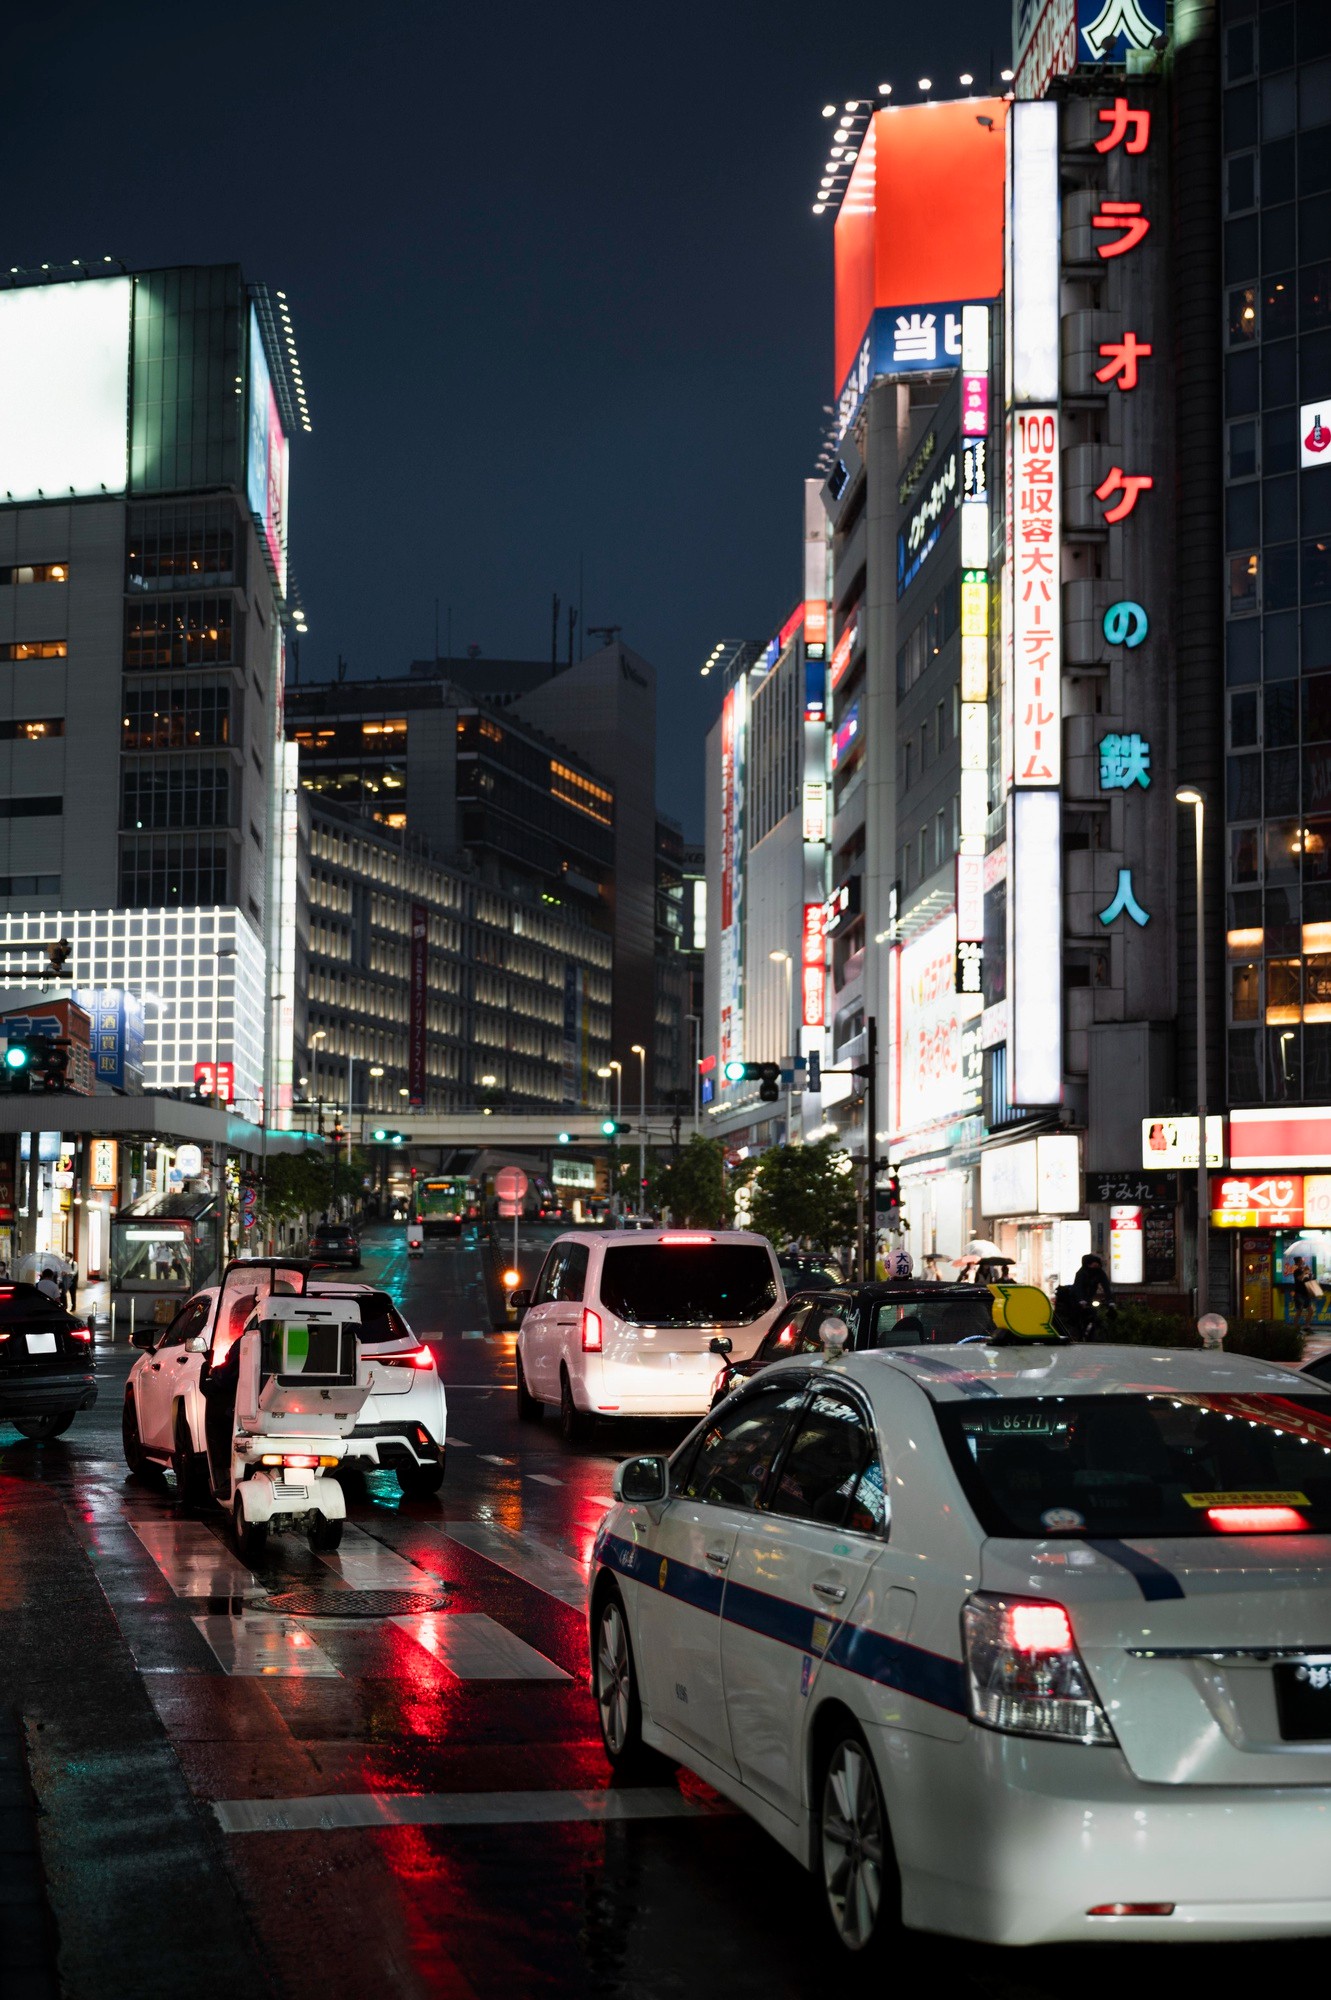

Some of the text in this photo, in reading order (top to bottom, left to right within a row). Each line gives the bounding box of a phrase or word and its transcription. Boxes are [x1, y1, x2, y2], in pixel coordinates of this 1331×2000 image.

[1093, 98, 1153, 926] カラオケの鉄人
[1019, 416, 1055, 778] 100名収容大パーティールーム
[1097, 1181, 1154, 1200] すみれ
[1221, 1180, 1294, 1209] 宝くじ
[895, 1252, 910, 1275] 大和
